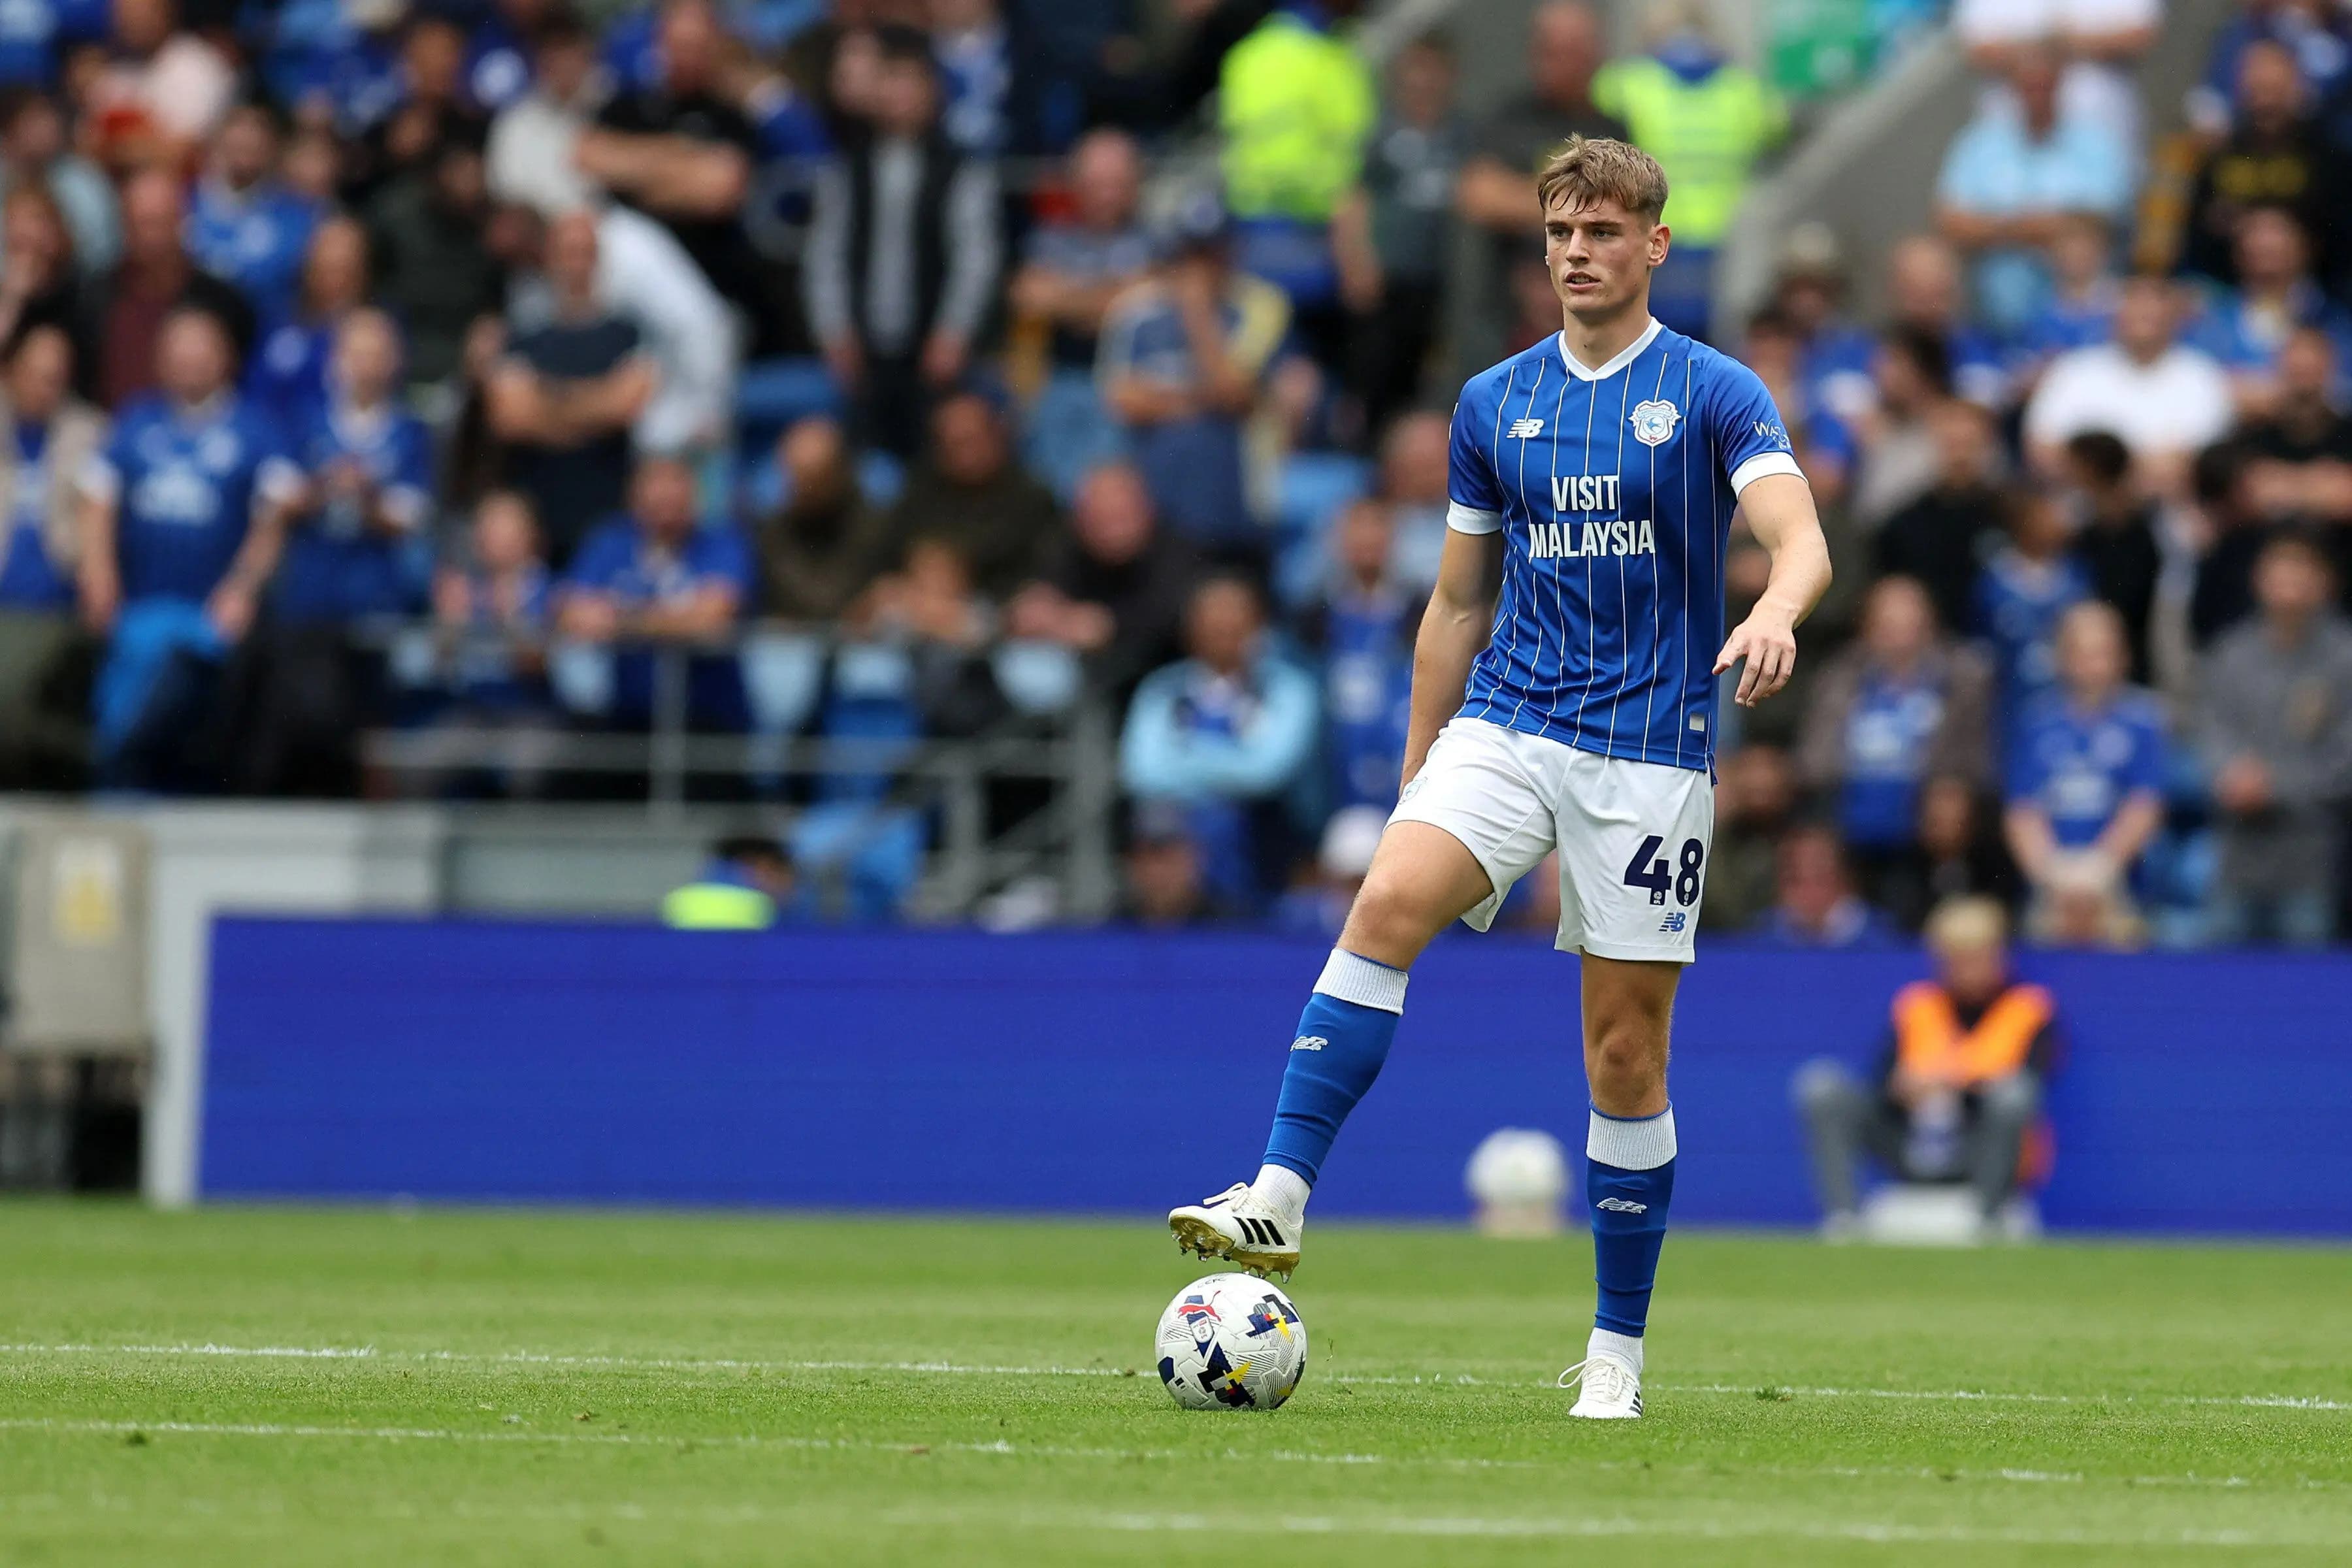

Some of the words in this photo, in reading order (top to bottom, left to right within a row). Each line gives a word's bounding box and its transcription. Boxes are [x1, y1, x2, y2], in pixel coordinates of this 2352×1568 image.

[1552, 475, 1619, 511] VISIT
[1528, 520, 1656, 558] MALAYSIA
[1624, 835, 1704, 907] 48
